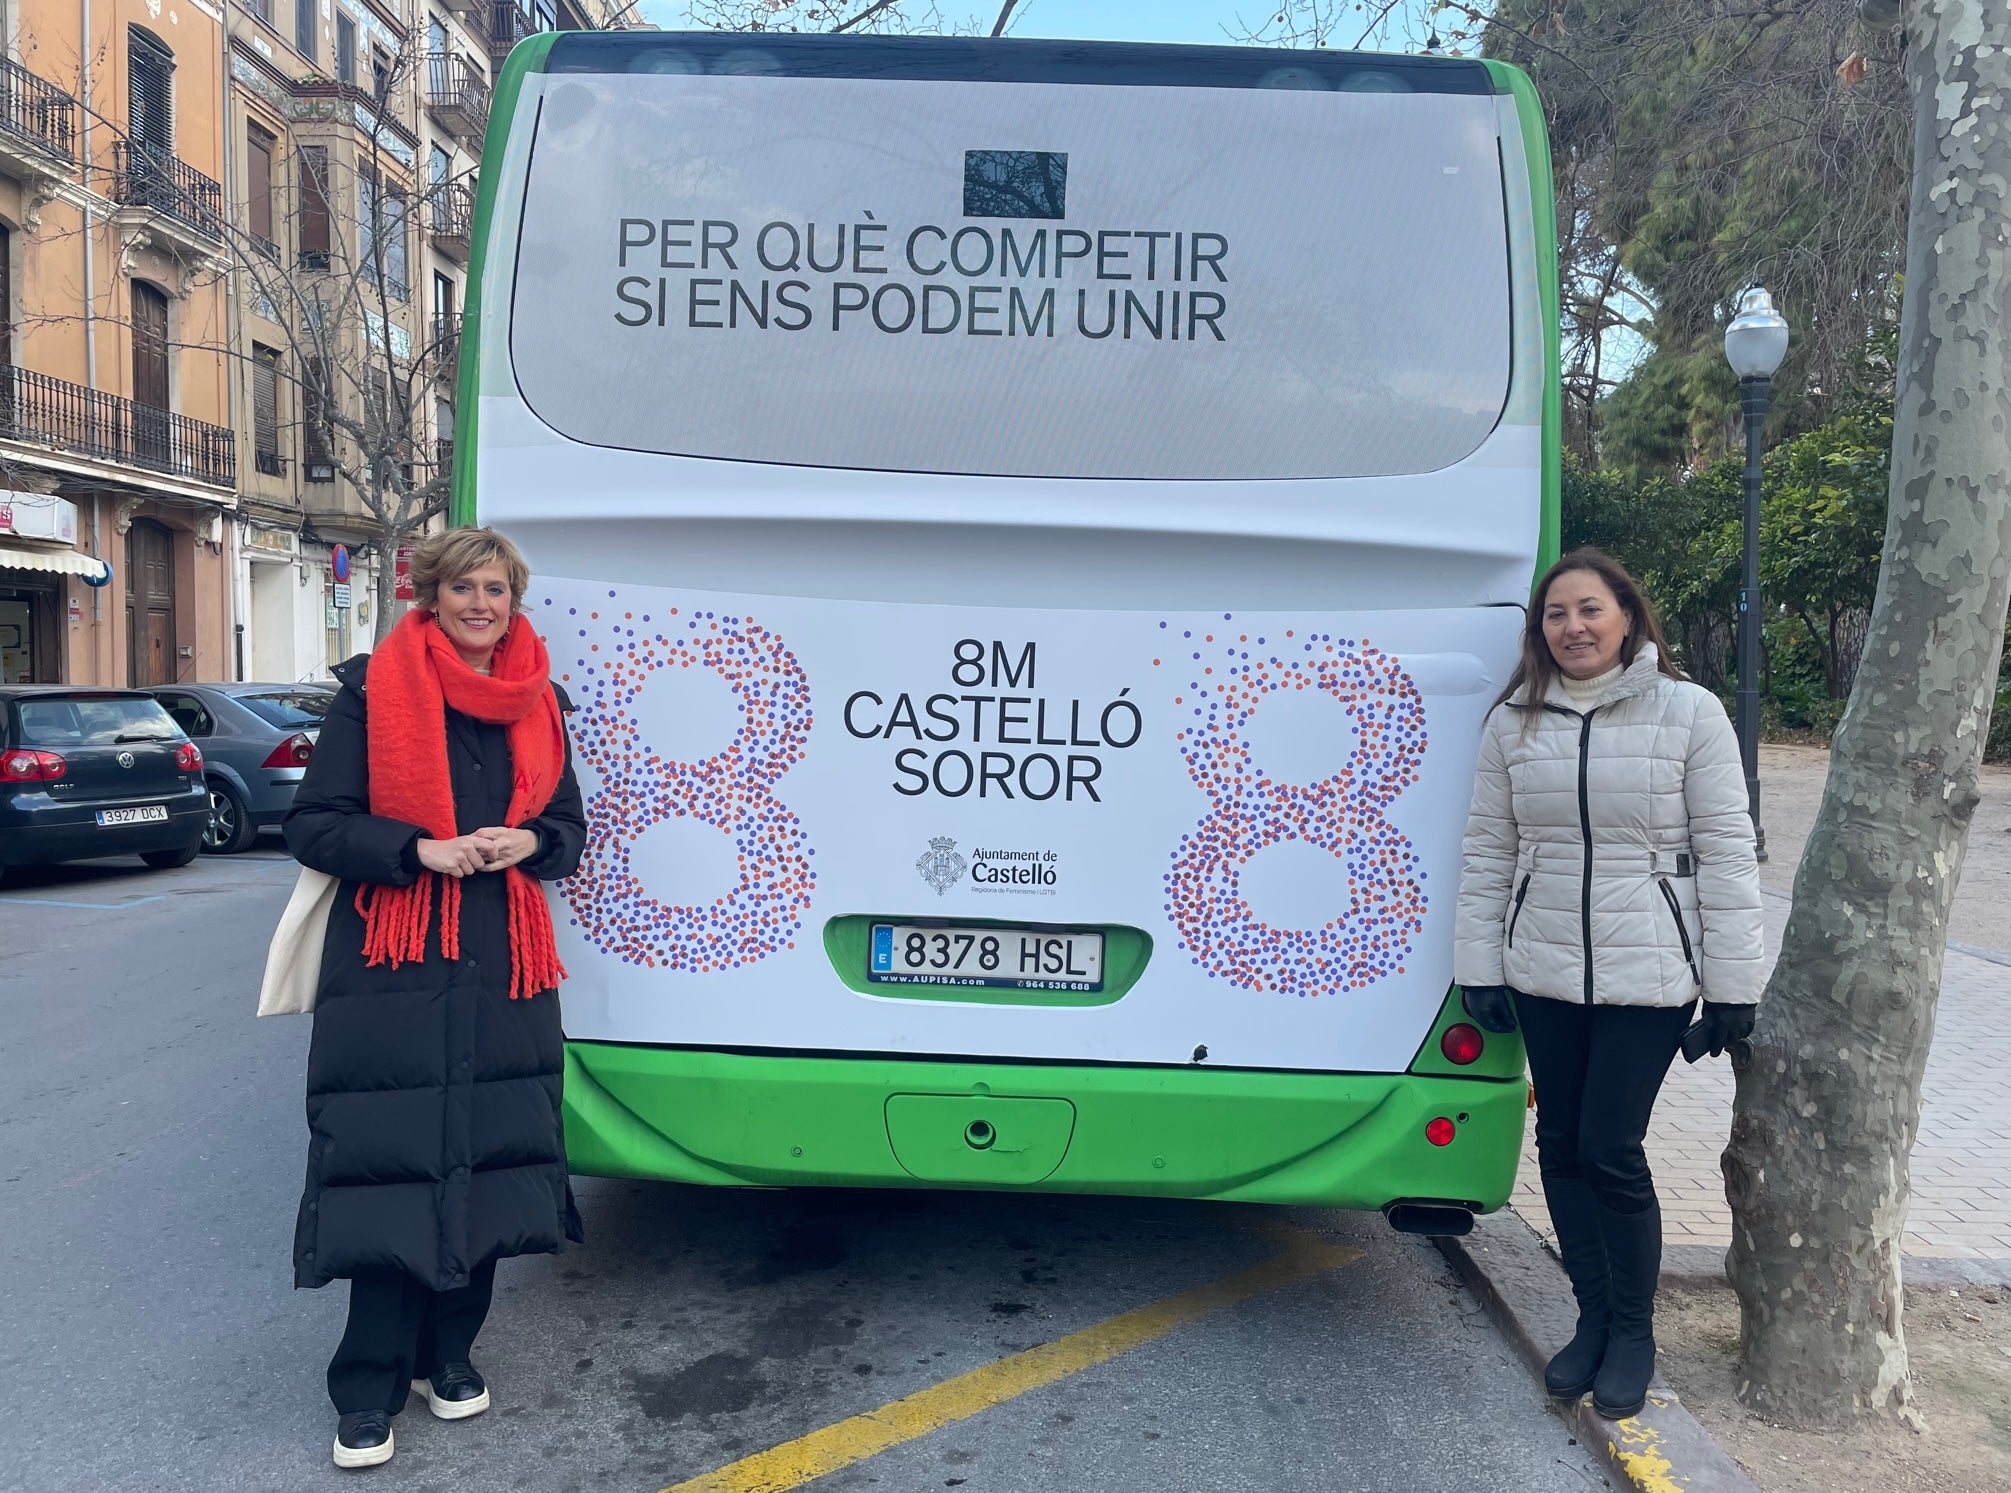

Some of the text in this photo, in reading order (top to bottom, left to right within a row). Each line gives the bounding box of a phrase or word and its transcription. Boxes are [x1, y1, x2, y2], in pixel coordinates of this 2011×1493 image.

[618, 210, 1229, 283] PER QUÈ COMPETIR
[613, 275, 1227, 342] SI ENS PODEM UNIR
[951, 639, 1036, 689] 8M
[843, 687, 1143, 749] CASTELLÓ
[892, 748, 1102, 803] SOROR
[105, 806, 165, 823] 3927 DCX
[971, 862, 1057, 885] Castelló
[972, 848, 1058, 862] Ajuntament de
[878, 932, 1087, 976] E 8378 HSL
[880, 975, 985, 986] www.AUPISA.com
[1025, 980, 1090, 991] 964 536 688
